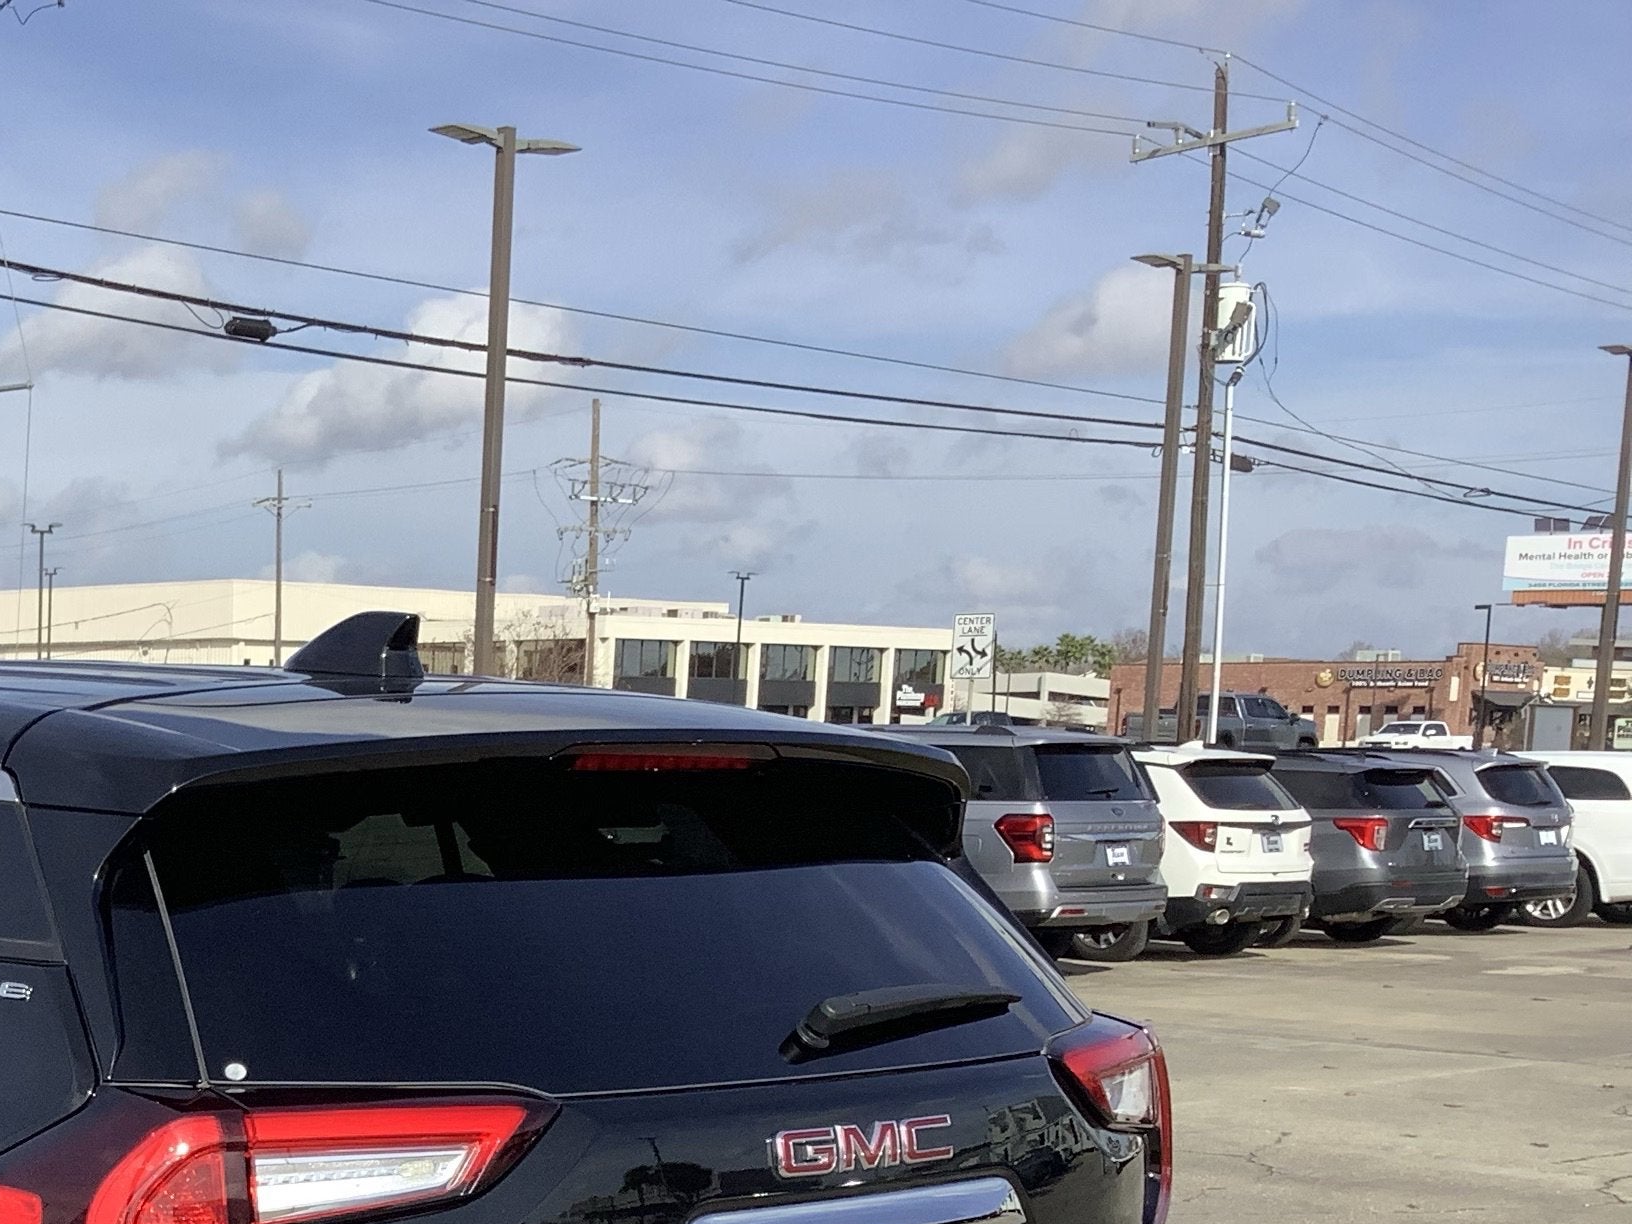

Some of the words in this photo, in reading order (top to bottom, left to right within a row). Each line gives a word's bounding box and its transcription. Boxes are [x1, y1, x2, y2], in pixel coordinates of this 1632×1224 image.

[1568, 537, 1583, 550] In
[1518, 552, 1556, 561] Mental
[1558, 552, 1594, 560] Health
[957, 616, 992, 625] CENTER
[961, 626, 986, 634] LANE
[958, 667, 983, 676] ONLY
[772, 1113, 954, 1178] GMC
